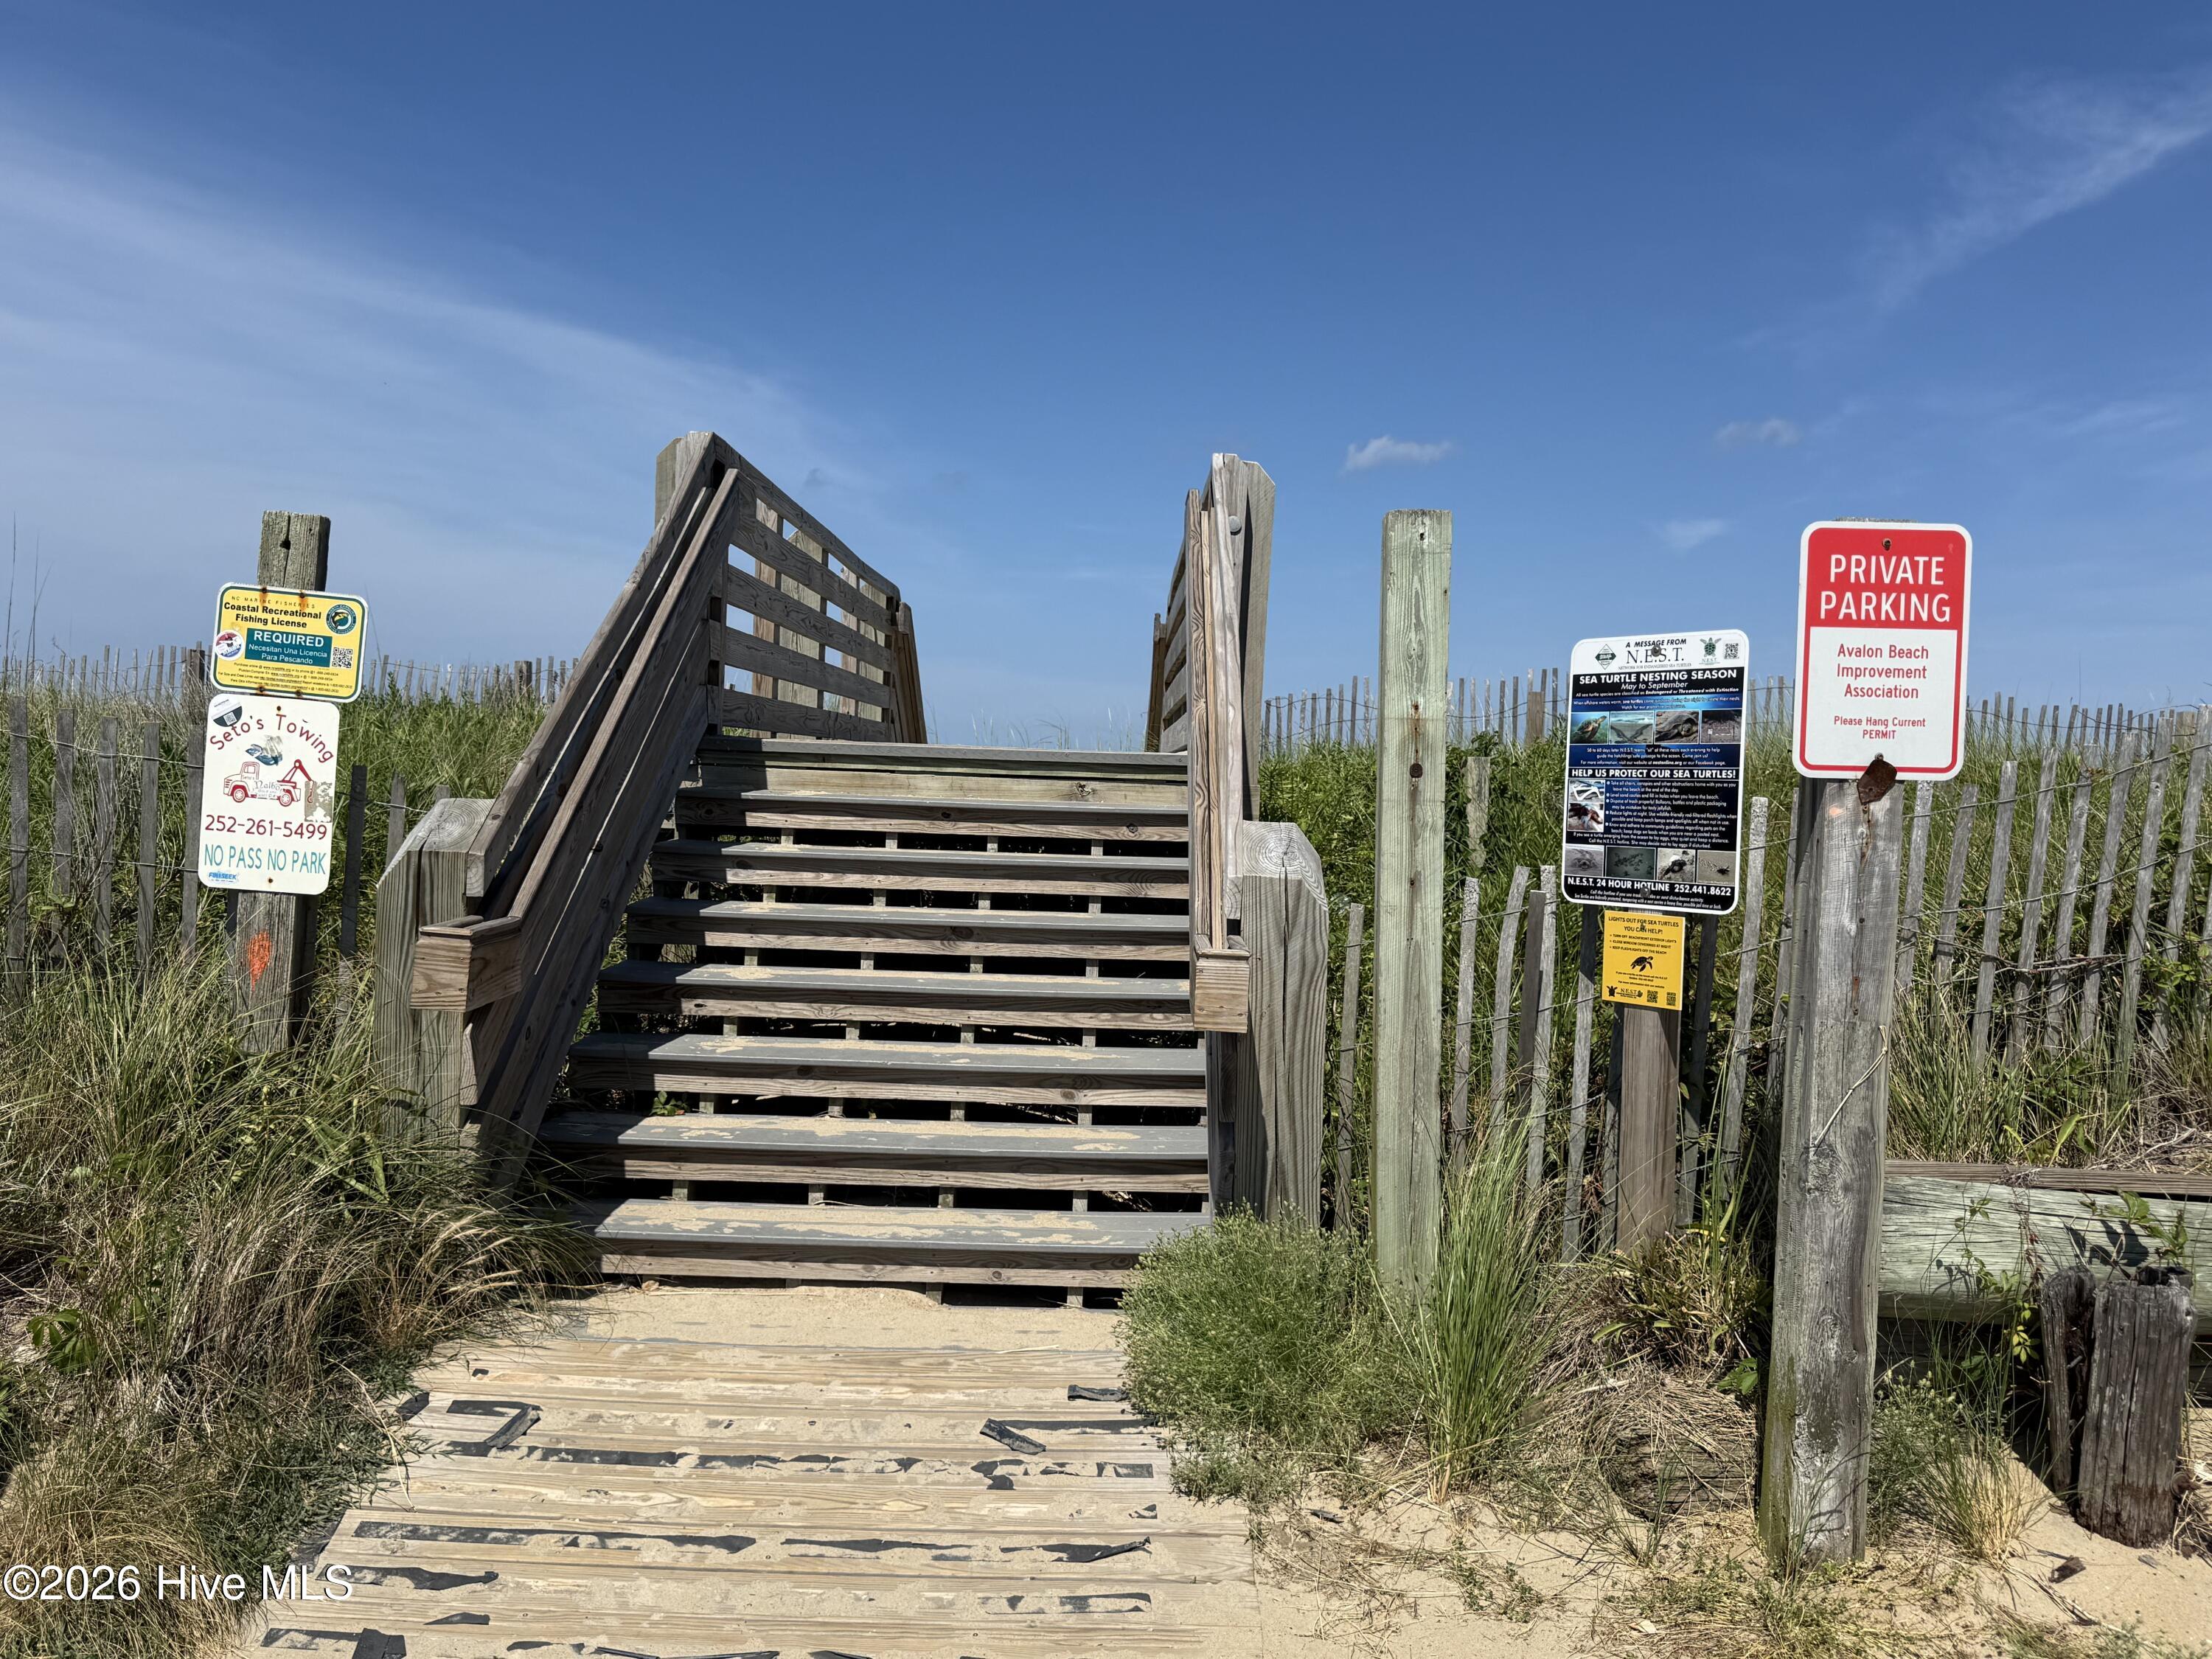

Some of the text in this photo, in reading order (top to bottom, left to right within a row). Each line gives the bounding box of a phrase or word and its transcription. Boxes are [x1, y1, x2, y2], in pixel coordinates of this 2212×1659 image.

[1829, 554, 1944, 585] PRIVATE
[224, 602, 259, 613] Coastal
[262, 605, 321, 619] Recreational
[276, 600, 315, 609] FISHERIES
[1820, 591, 1951, 622] PARKING
[235, 613, 307, 627] Fishing License
[254, 630, 324, 647] REQUIRED
[1634, 639, 1665, 647] MESSAGE
[249, 643, 282, 653] Necesitan
[284, 647, 298, 655] Una
[299, 648, 327, 658] Licencia
[1627, 647, 1684, 664] N.E.S.T.
[1837, 643, 1929, 659] Avalon Beach
[262, 653, 313, 664] Para Pescando
[1579, 669, 1736, 684] SEA TURTLE NESTING SEASON
[1837, 663, 1927, 681] Improvement
[1648, 681, 1688, 689] September
[1844, 684, 1919, 698] Association
[1834, 715, 1926, 728] Please Hang Current
[209, 713, 334, 763] Seto's Towing
[1863, 729, 1896, 740] PERMIT
[1571, 768, 1736, 778] HELP US PROTECT OUR SEA TURTLES!
[205, 814, 327, 840] 252-261-5499
[204, 844, 327, 874] NO PASS NO PARK
[1568, 877, 1731, 896] N.E.S.T. 24 HOUR HOTLINE 252.441.8622
